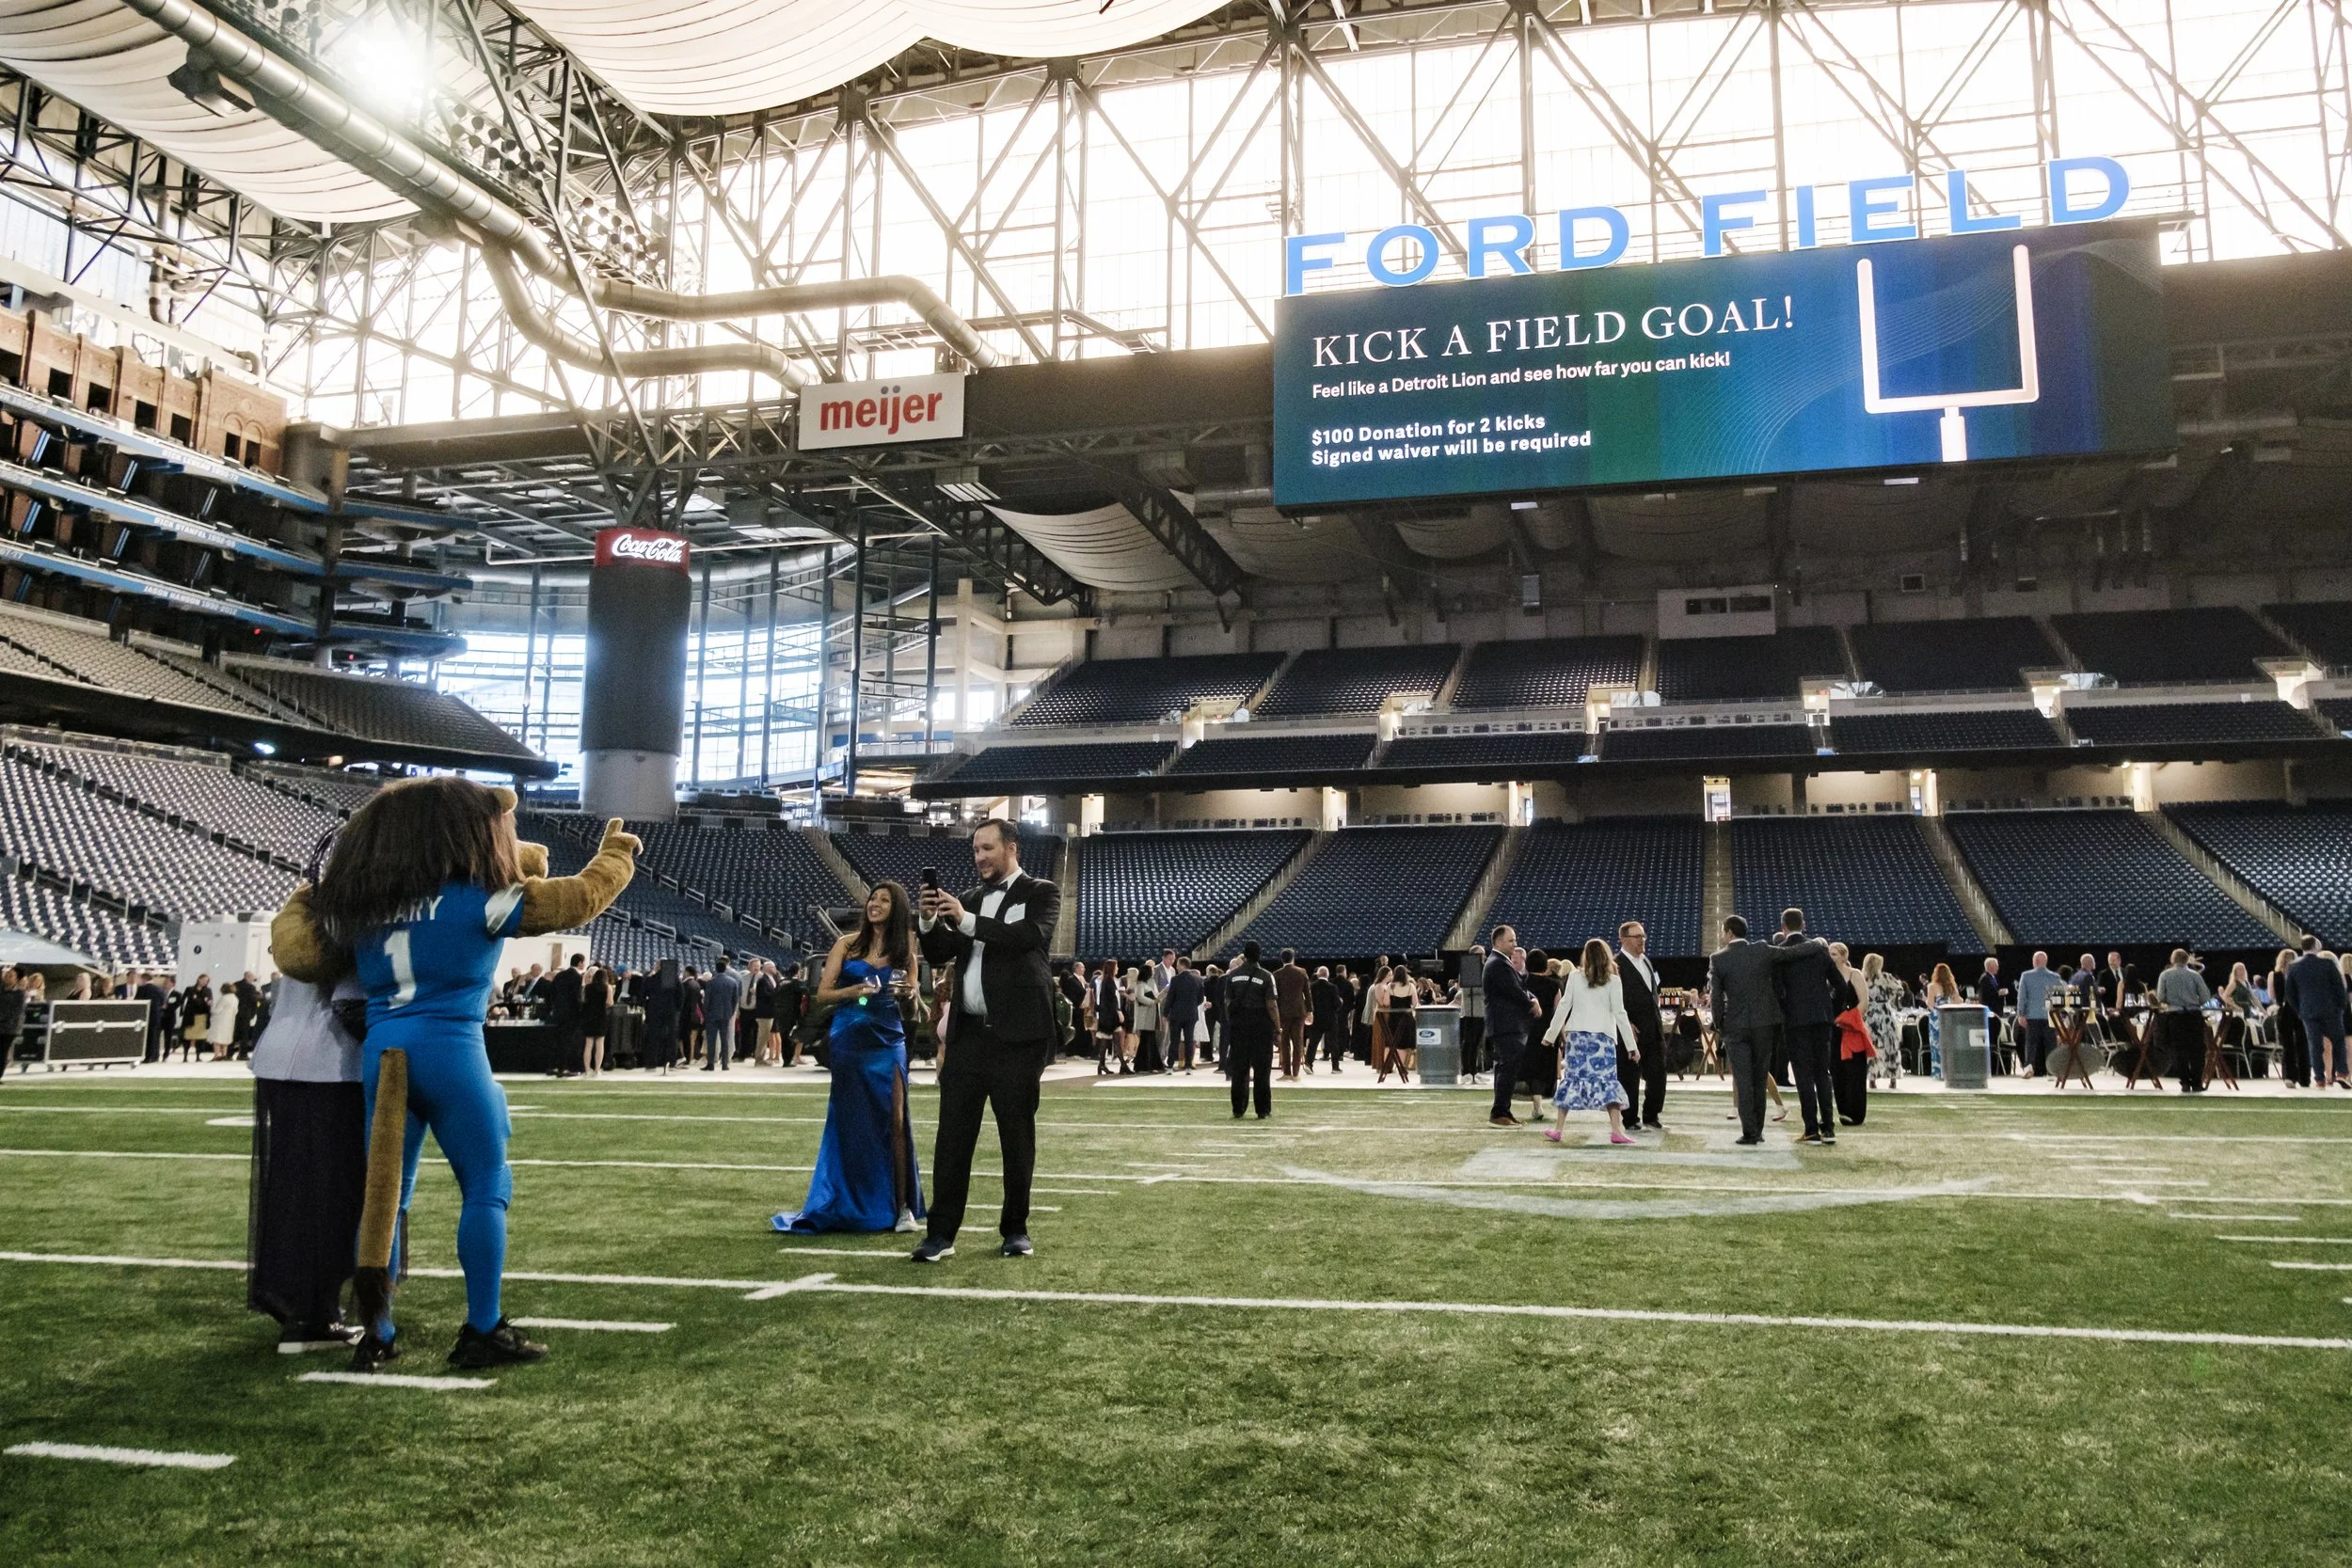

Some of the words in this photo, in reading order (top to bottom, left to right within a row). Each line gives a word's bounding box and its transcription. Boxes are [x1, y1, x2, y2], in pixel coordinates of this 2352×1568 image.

[1285, 205, 1630, 297] FORD
[1701, 155, 2131, 258] FIELD
[1312, 327, 1428, 367] KICK
[1441, 325, 1472, 356] A
[1486, 311, 1627, 354] FIELD
[1641, 295, 1793, 340] GOAL!
[1312, 382, 1344, 399] Feel
[1348, 380, 1375, 396] like
[1378, 382, 1389, 394] a
[1391, 373, 1449, 393] Detroit
[1452, 372, 1486, 388] Lion
[1489, 368, 1520, 385] and
[1523, 370, 1552, 382] see
[1556, 364, 1592, 380] how
[1594, 360, 1616, 377] far
[1620, 360, 1652, 378] you
[1655, 357, 1686, 372] can
[1690, 351, 1730, 369] kick!
[820, 385, 943, 435] meijer
[1311, 427, 1354, 447] $100
[1359, 422, 1443, 442] Donation
[1447, 420, 1475, 436] for
[1480, 417, 1491, 433] 2
[1495, 414, 1546, 432] kicks
[1311, 446, 1374, 467] Signed
[1377, 443, 1440, 460] waiver
[1444, 438, 1478, 456] will
[1483, 438, 1505, 453] be
[1510, 431, 1592, 454] required
[612, 533, 688, 562] Coca-Cola
[383, 928, 418, 1010] 1
